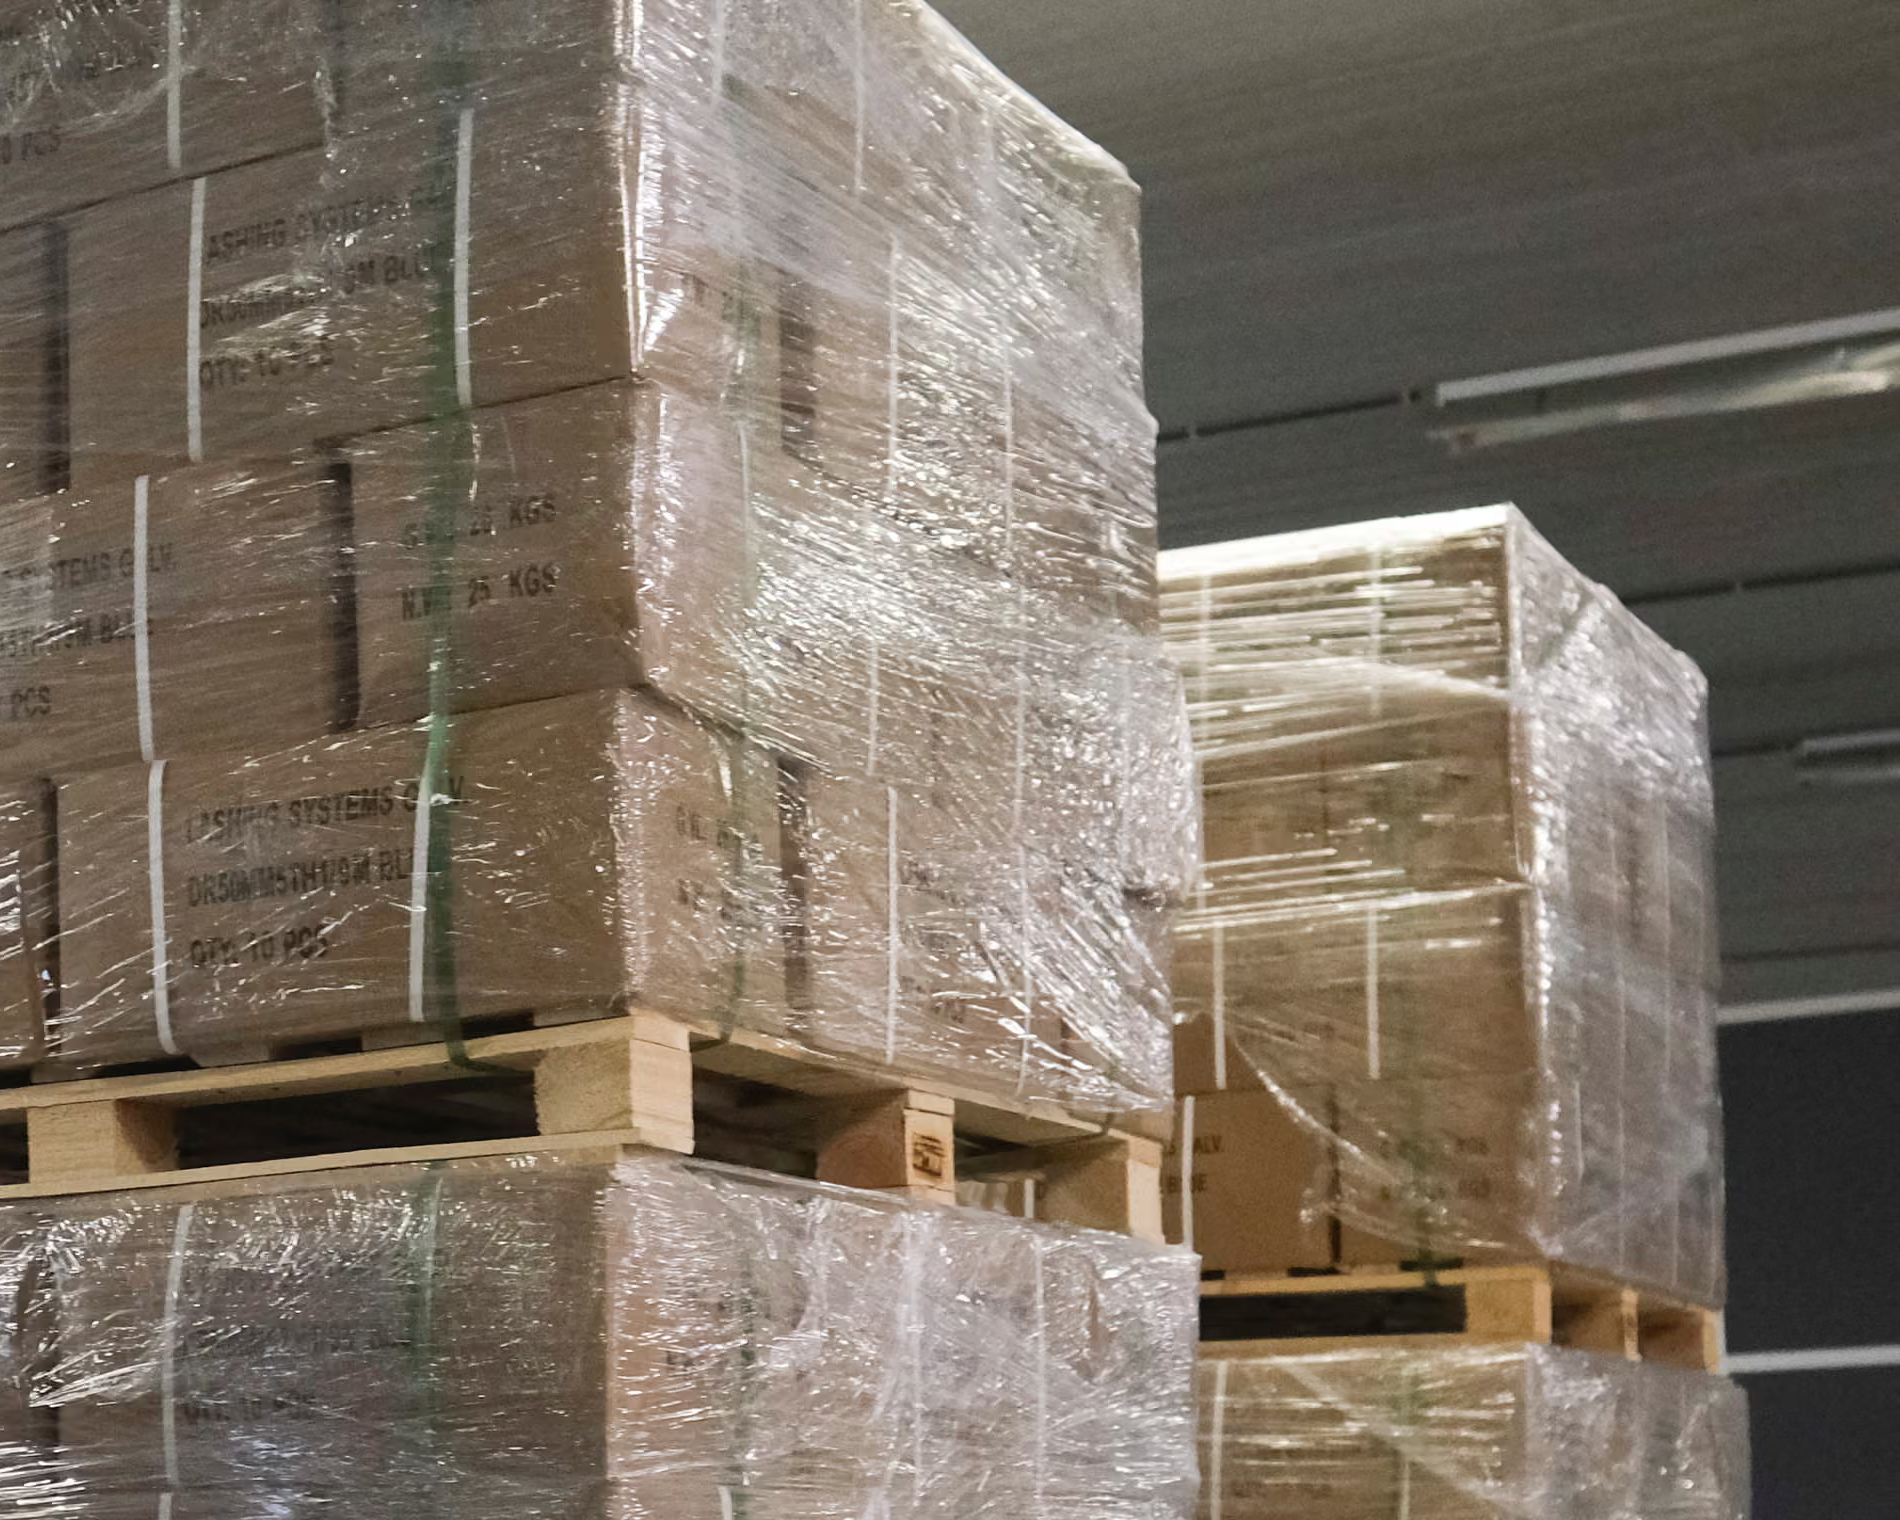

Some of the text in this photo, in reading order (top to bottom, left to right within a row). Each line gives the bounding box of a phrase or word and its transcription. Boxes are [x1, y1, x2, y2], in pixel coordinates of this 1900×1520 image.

[508, 560, 559, 598] KGS
[10, 685, 52, 721] PCS
[288, 785, 395, 830] SYSTEMS
[282, 923, 330, 961] PCS
